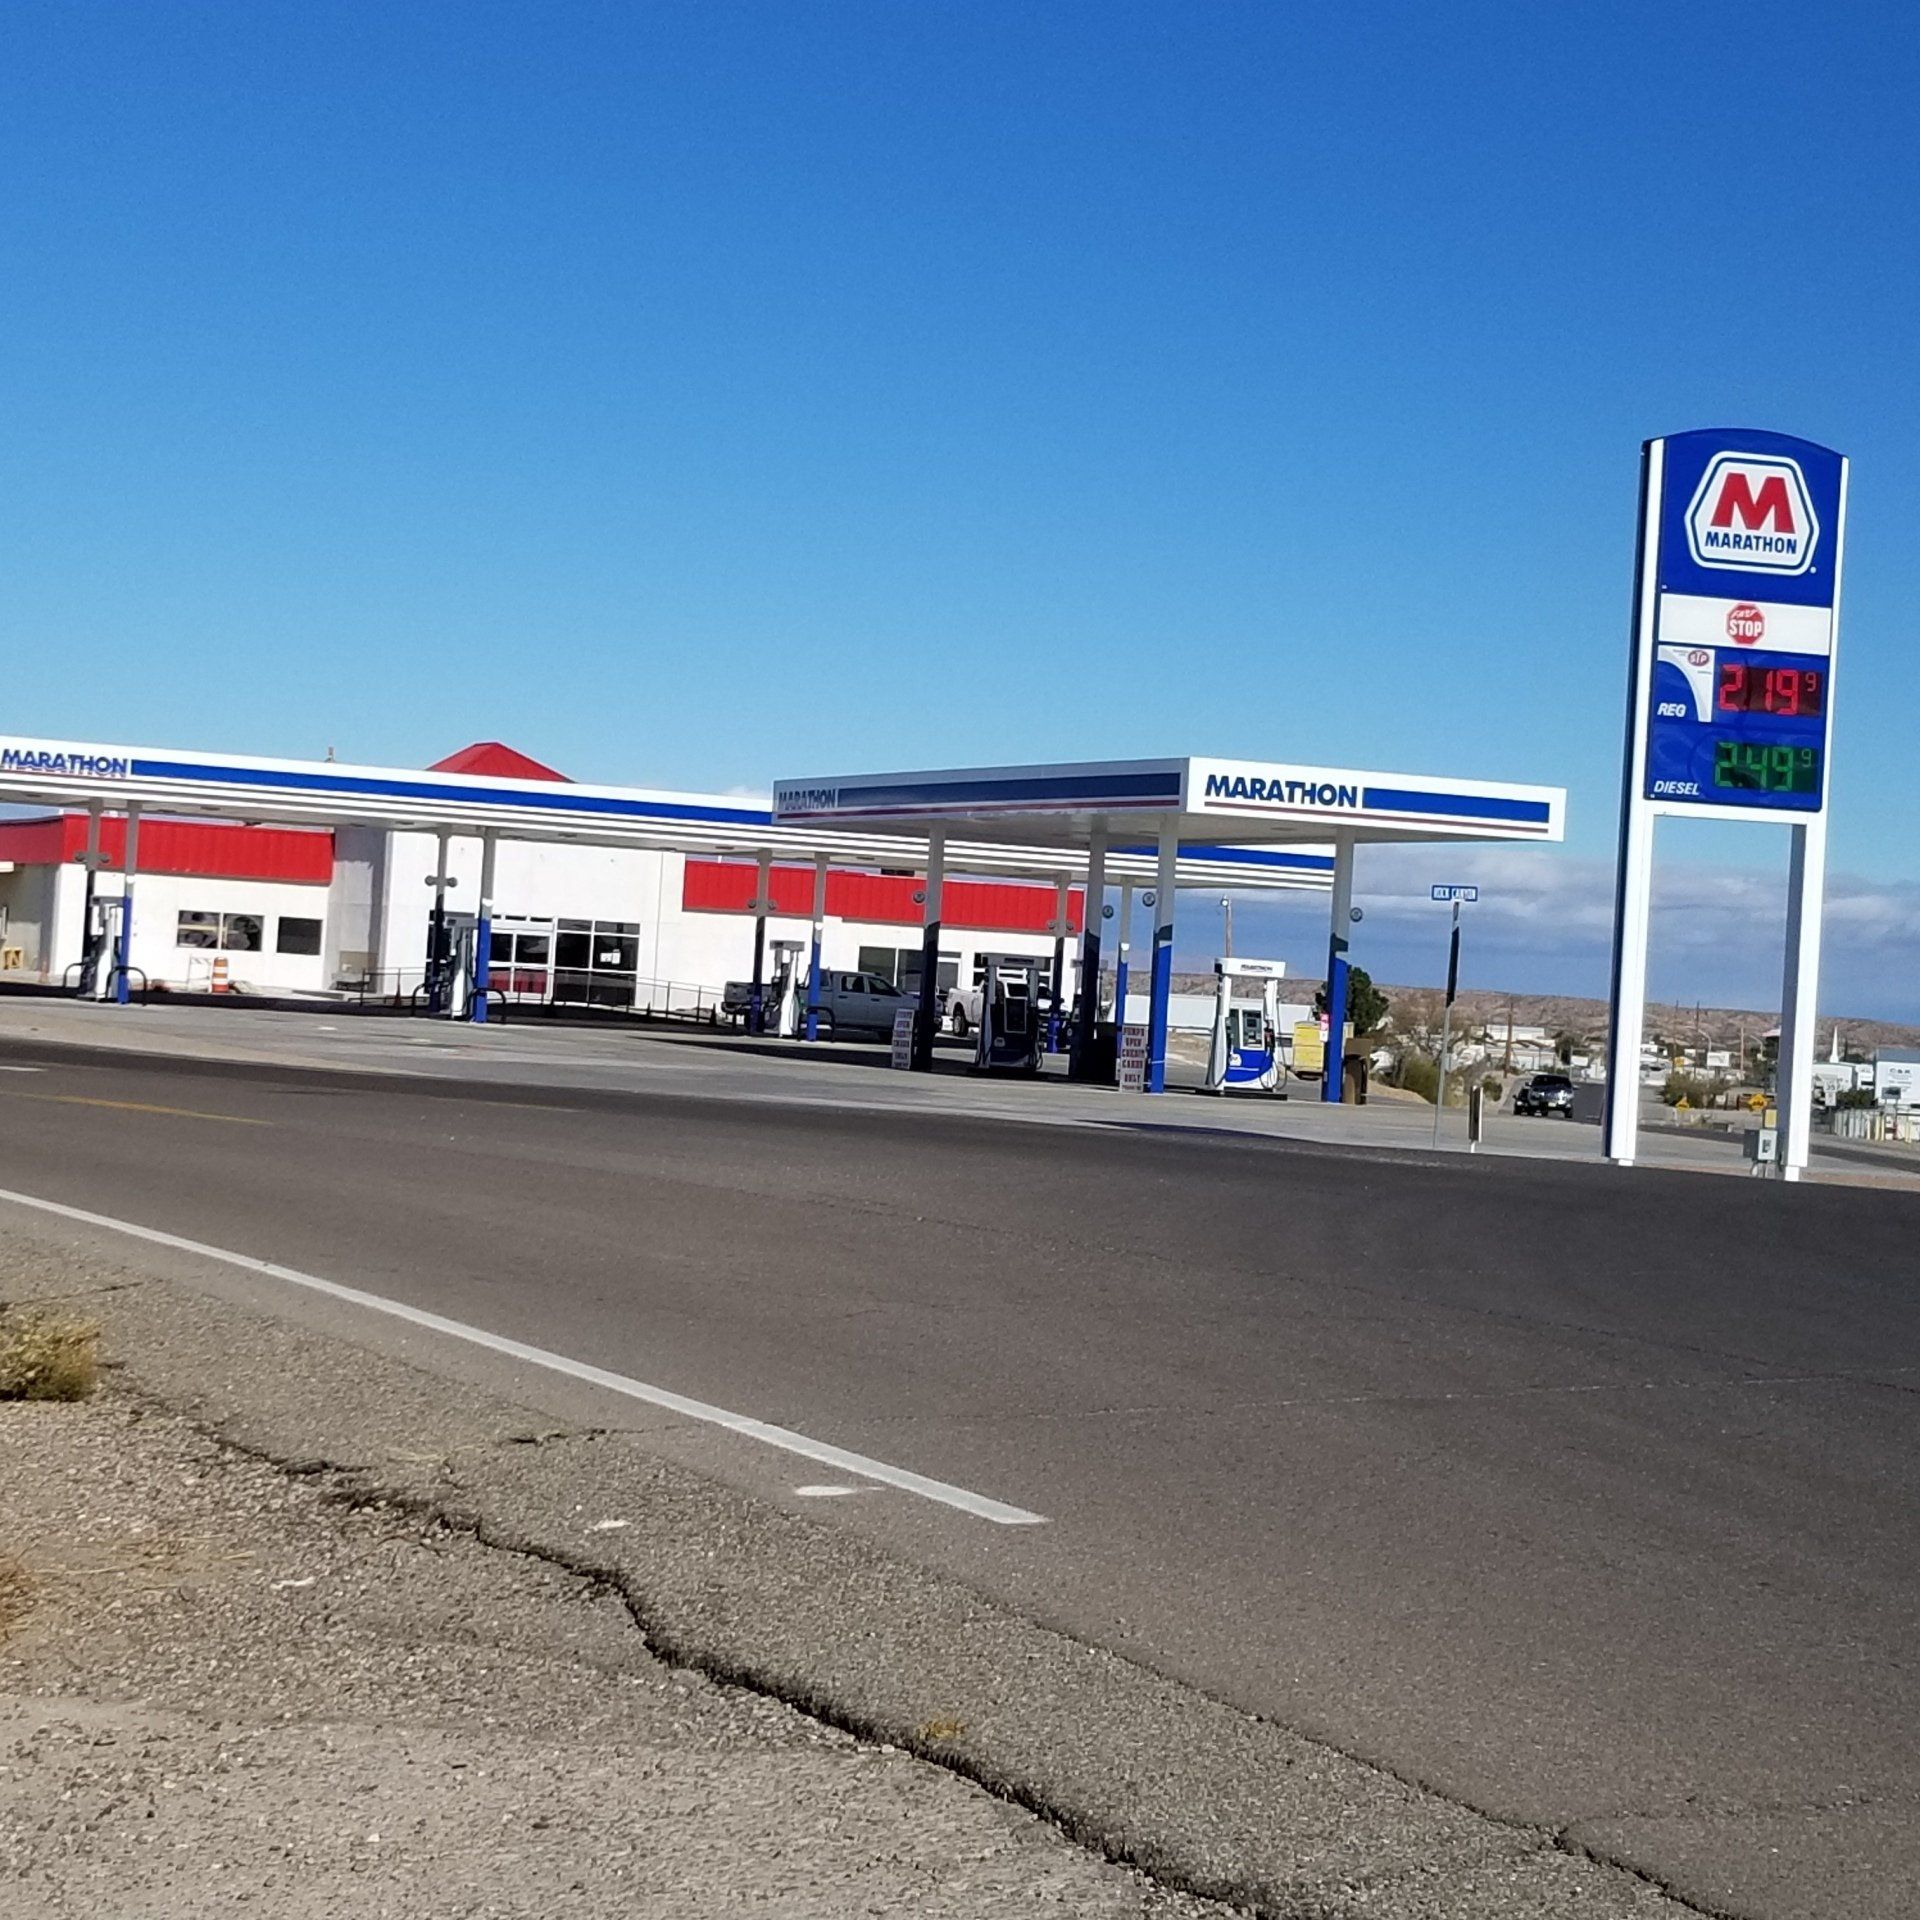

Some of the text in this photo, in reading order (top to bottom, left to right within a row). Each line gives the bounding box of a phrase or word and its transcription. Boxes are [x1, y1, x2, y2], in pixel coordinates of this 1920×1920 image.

[1710, 472, 1796, 534] M
[1704, 530, 1797, 555] MARATHON
[1729, 619, 1763, 638] STOP
[1657, 702, 1687, 718] REG
[1, 748, 128, 774] MARATHON
[1204, 774, 1358, 808] MARATHON
[1653, 780, 1701, 796] DIESEL
[778, 789, 837, 811] MARATHON
